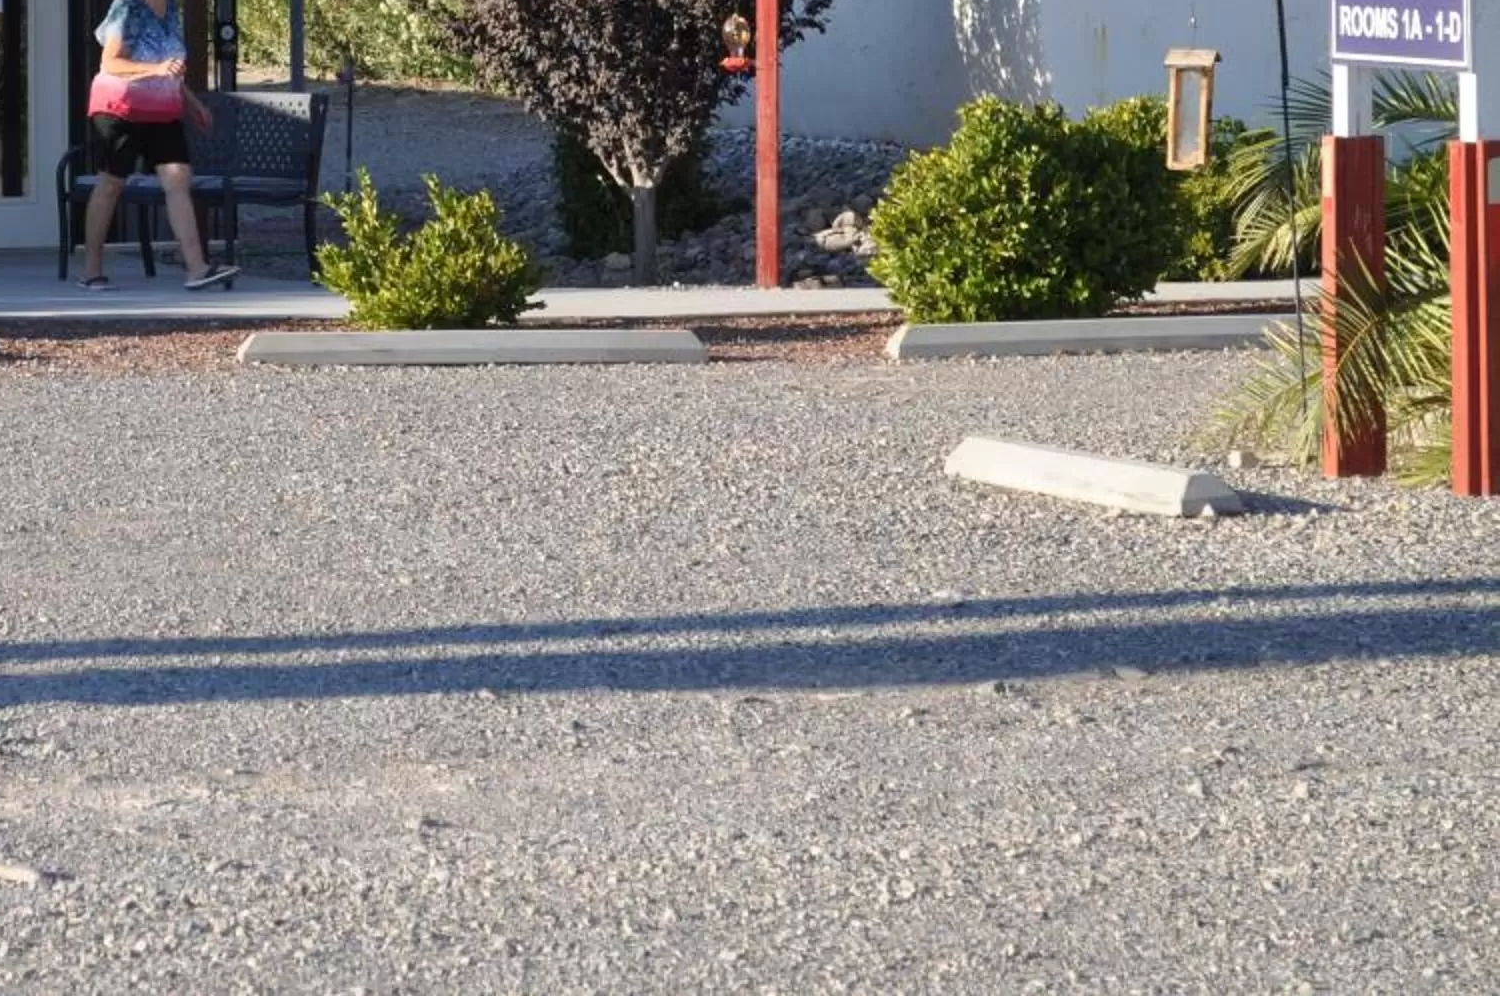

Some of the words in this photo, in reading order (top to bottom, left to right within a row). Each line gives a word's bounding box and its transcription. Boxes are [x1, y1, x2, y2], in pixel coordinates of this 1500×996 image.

[1339, 5, 1399, 40] ROOMS
[1402, 7, 1423, 41] 1A
[1436, 9, 1462, 44] 1-D
